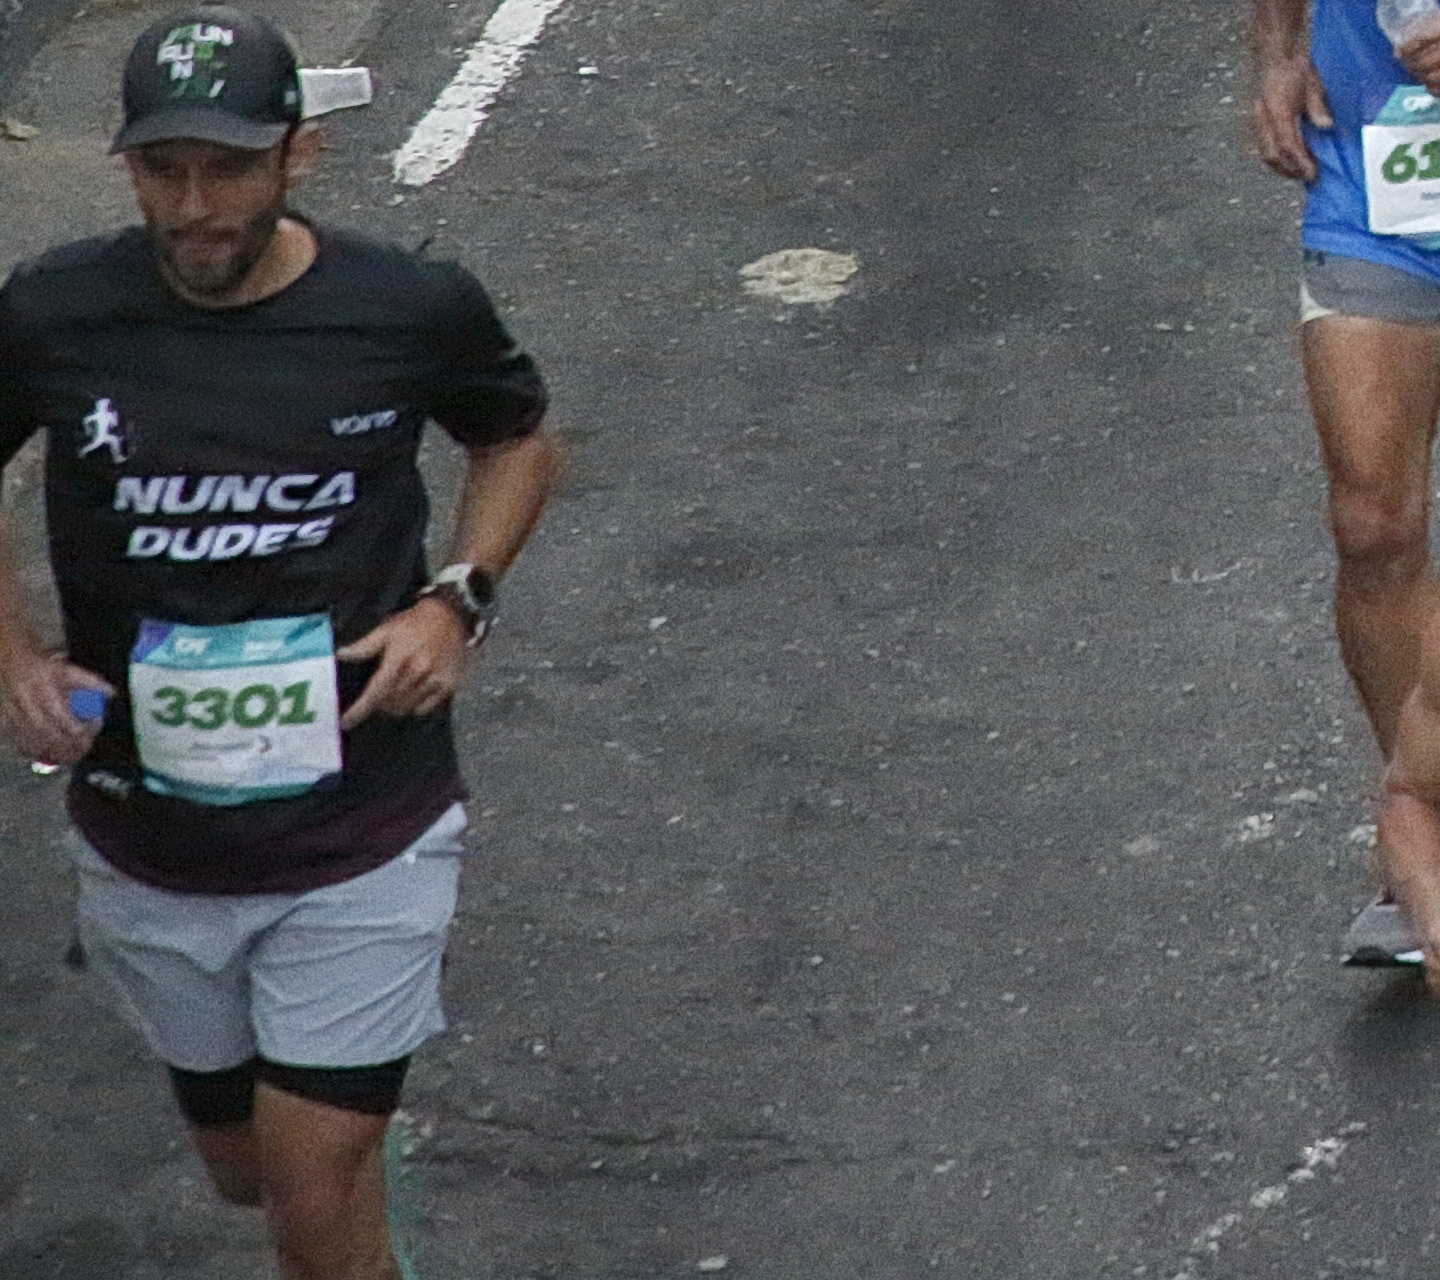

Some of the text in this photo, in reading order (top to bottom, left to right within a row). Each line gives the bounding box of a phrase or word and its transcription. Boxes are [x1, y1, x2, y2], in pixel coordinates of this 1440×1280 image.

[112, 472, 357, 514] NUNCA
[126, 516, 336, 562] DUDES
[151, 681, 319, 731] 3301
